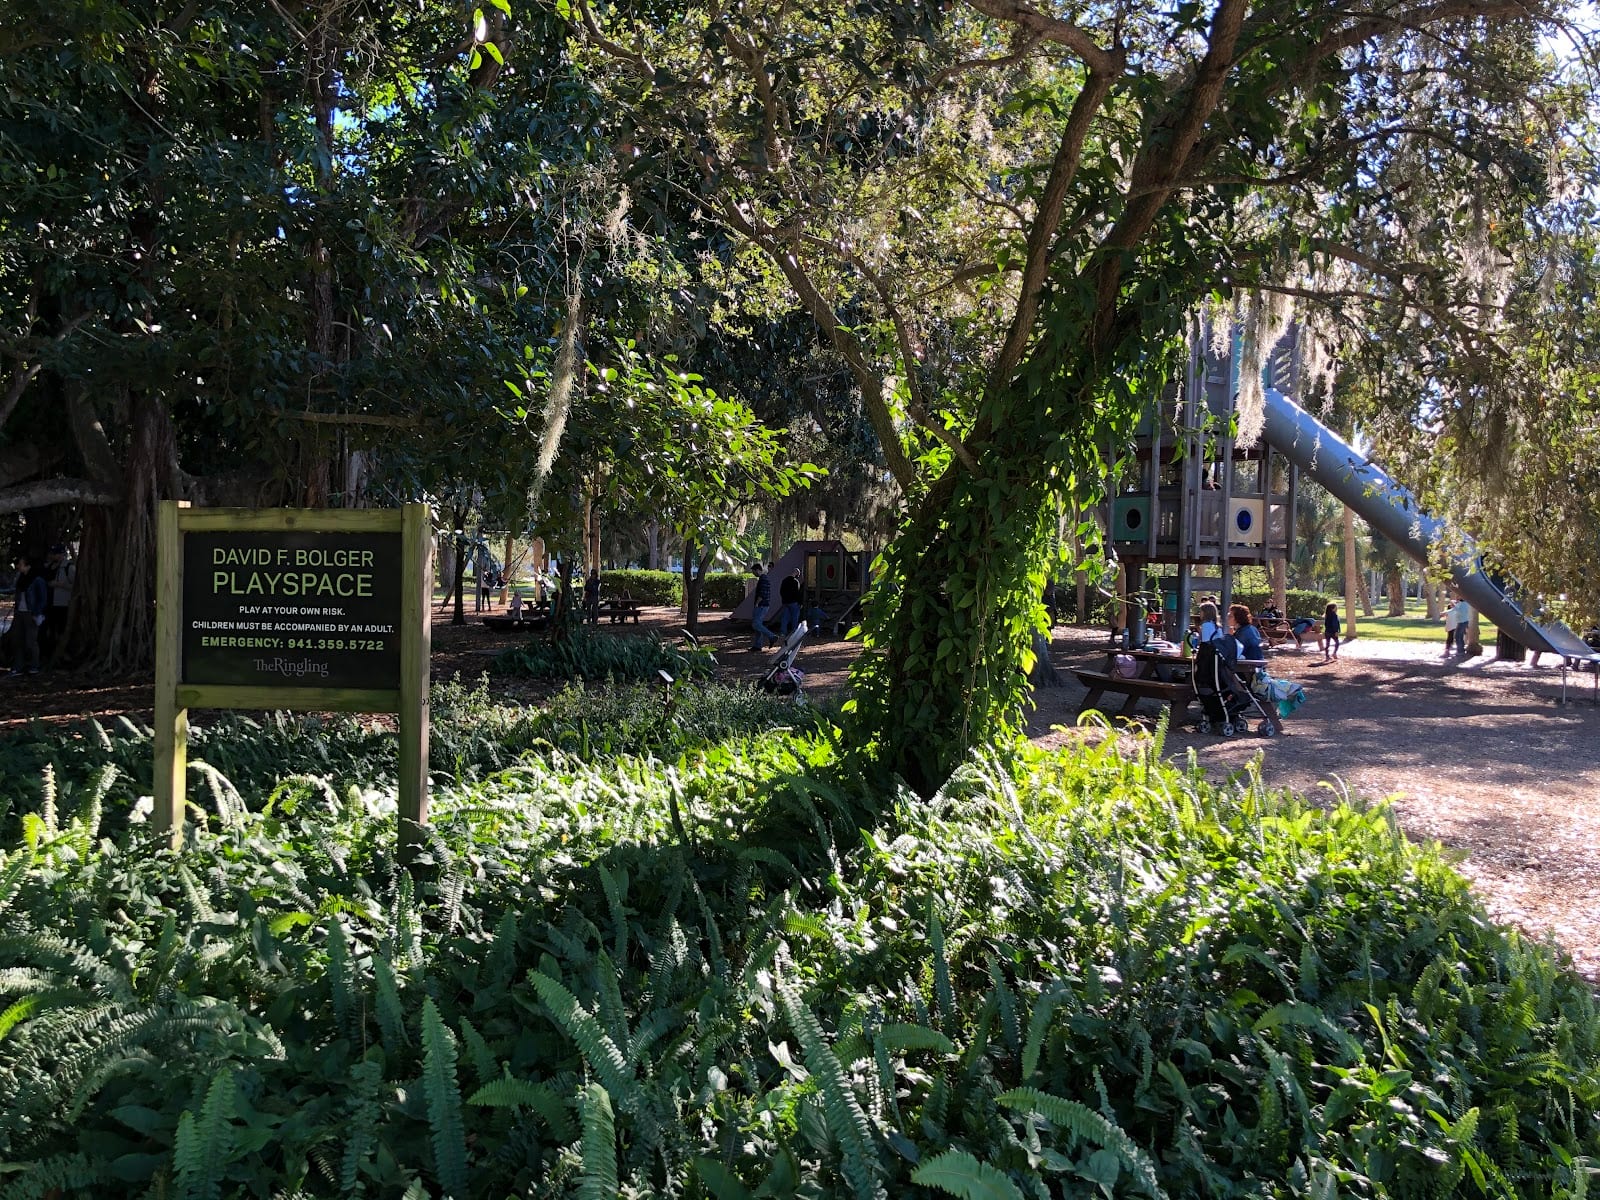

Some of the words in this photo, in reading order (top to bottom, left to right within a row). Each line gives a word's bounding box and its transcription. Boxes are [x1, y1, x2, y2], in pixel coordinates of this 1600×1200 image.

[213, 548, 271, 566] DAVID
[277, 549, 291, 566] F.
[295, 549, 374, 567] BOLGER
[213, 571, 373, 597] PLAYSPACE
[239, 605, 261, 615] PLAY
[262, 606, 273, 615] AT
[273, 606, 298, 615] YOUR
[299, 607, 321, 616] OWN
[322, 607, 346, 616] RISK.
[192, 620, 235, 630] CHILDREN
[236, 621, 260, 630] MUST
[261, 622, 273, 631] BE
[274, 622, 337, 632] ACCOMPANIED
[337, 624, 350, 633] BY
[350, 624, 363, 633] AN
[364, 624, 394, 633] ADULT.
[202, 636, 284, 649] EMERGENCY:
[288, 638, 384, 650] 941.359.5722
